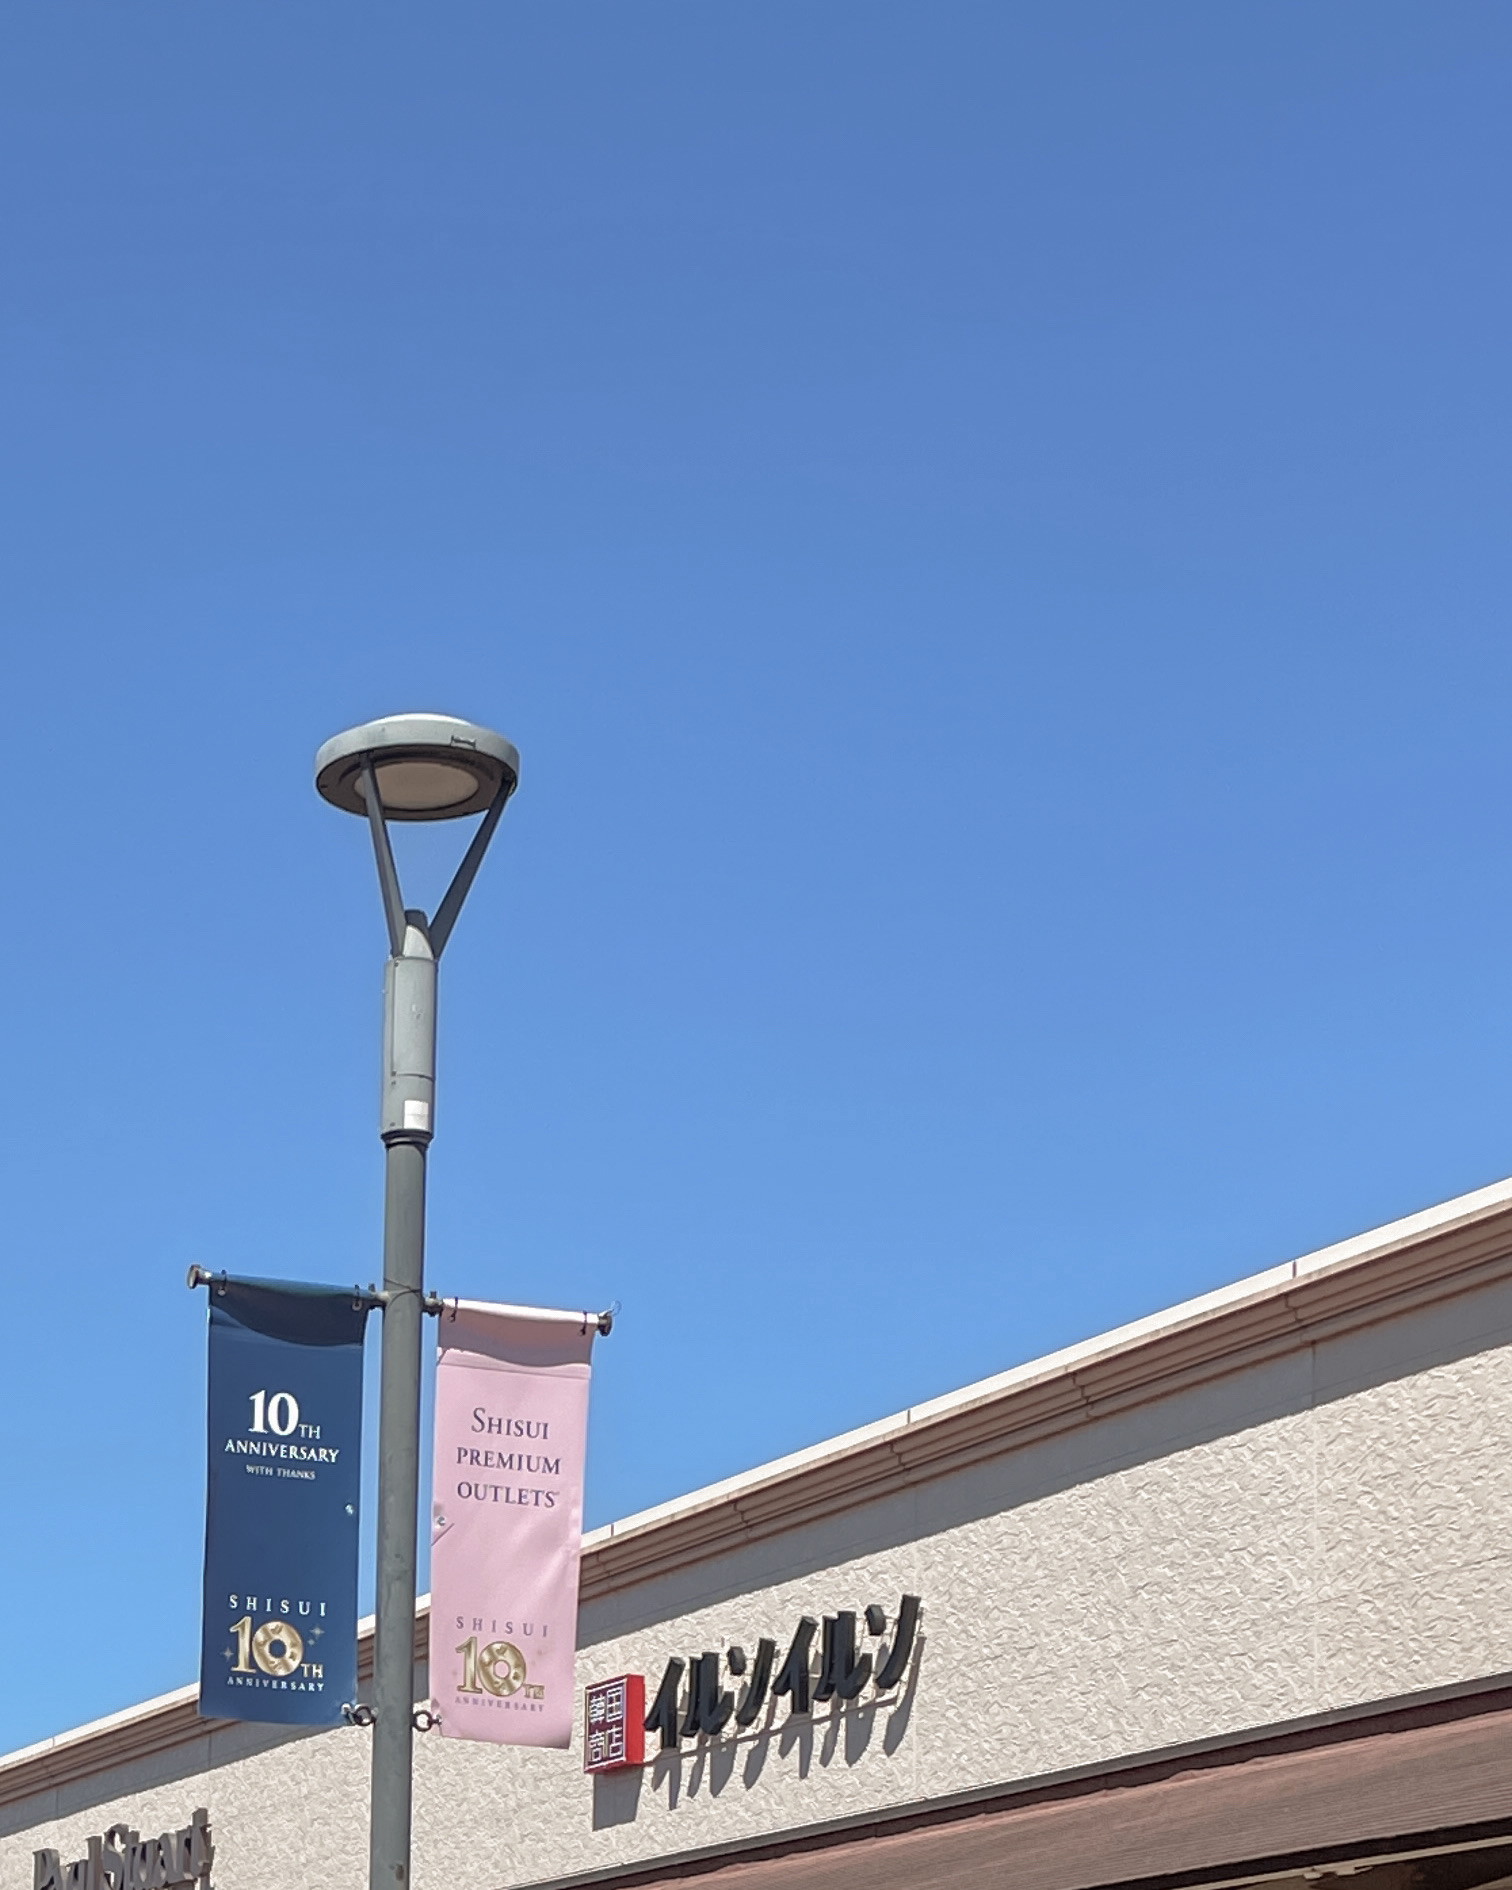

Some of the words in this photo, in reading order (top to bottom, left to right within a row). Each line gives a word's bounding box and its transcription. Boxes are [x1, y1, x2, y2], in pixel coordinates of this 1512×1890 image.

[247, 1389, 321, 1440] 10TH
[224, 1438, 340, 1463] ANNIVERSARY
[456, 1446, 562, 1475] PREMIUM
[245, 1464, 274, 1477] WITH
[276, 1467, 316, 1481] THANKS
[457, 1481, 558, 1509] OUTLETS
[228, 1594, 326, 1617] SHISUI
[455, 1615, 548, 1638] SHISUI
[227, 1676, 325, 1692] ANNIVERSARY
[454, 1696, 545, 1713] ANNIVERSARY
